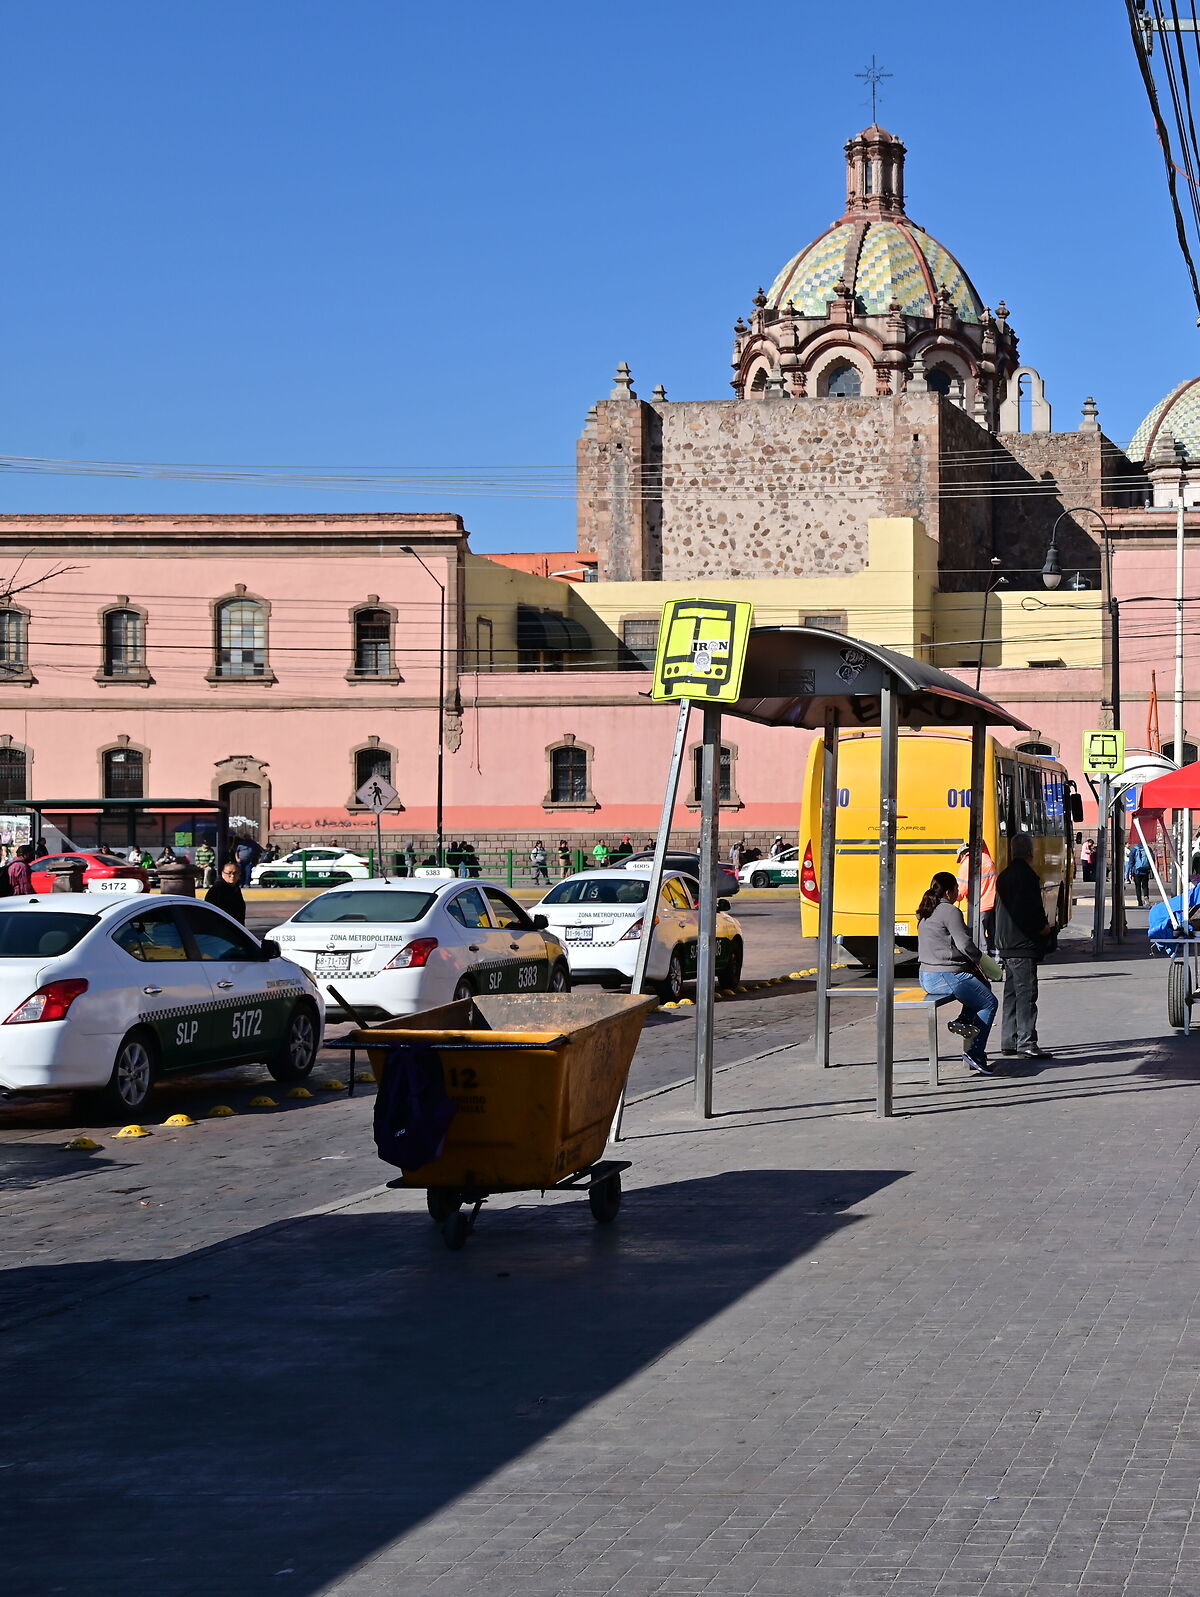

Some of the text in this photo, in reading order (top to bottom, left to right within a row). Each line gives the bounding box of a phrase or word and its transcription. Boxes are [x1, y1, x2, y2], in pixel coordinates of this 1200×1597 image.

[101, 882, 127, 890] 5172
[348, 934, 403, 942] METROPOLITANA
[489, 971, 502, 990] SLP
[518, 965, 538, 989] 5383
[176, 1020, 199, 1046] SLP
[232, 1009, 263, 1040] 5172
[448, 1067, 479, 1089] 12
